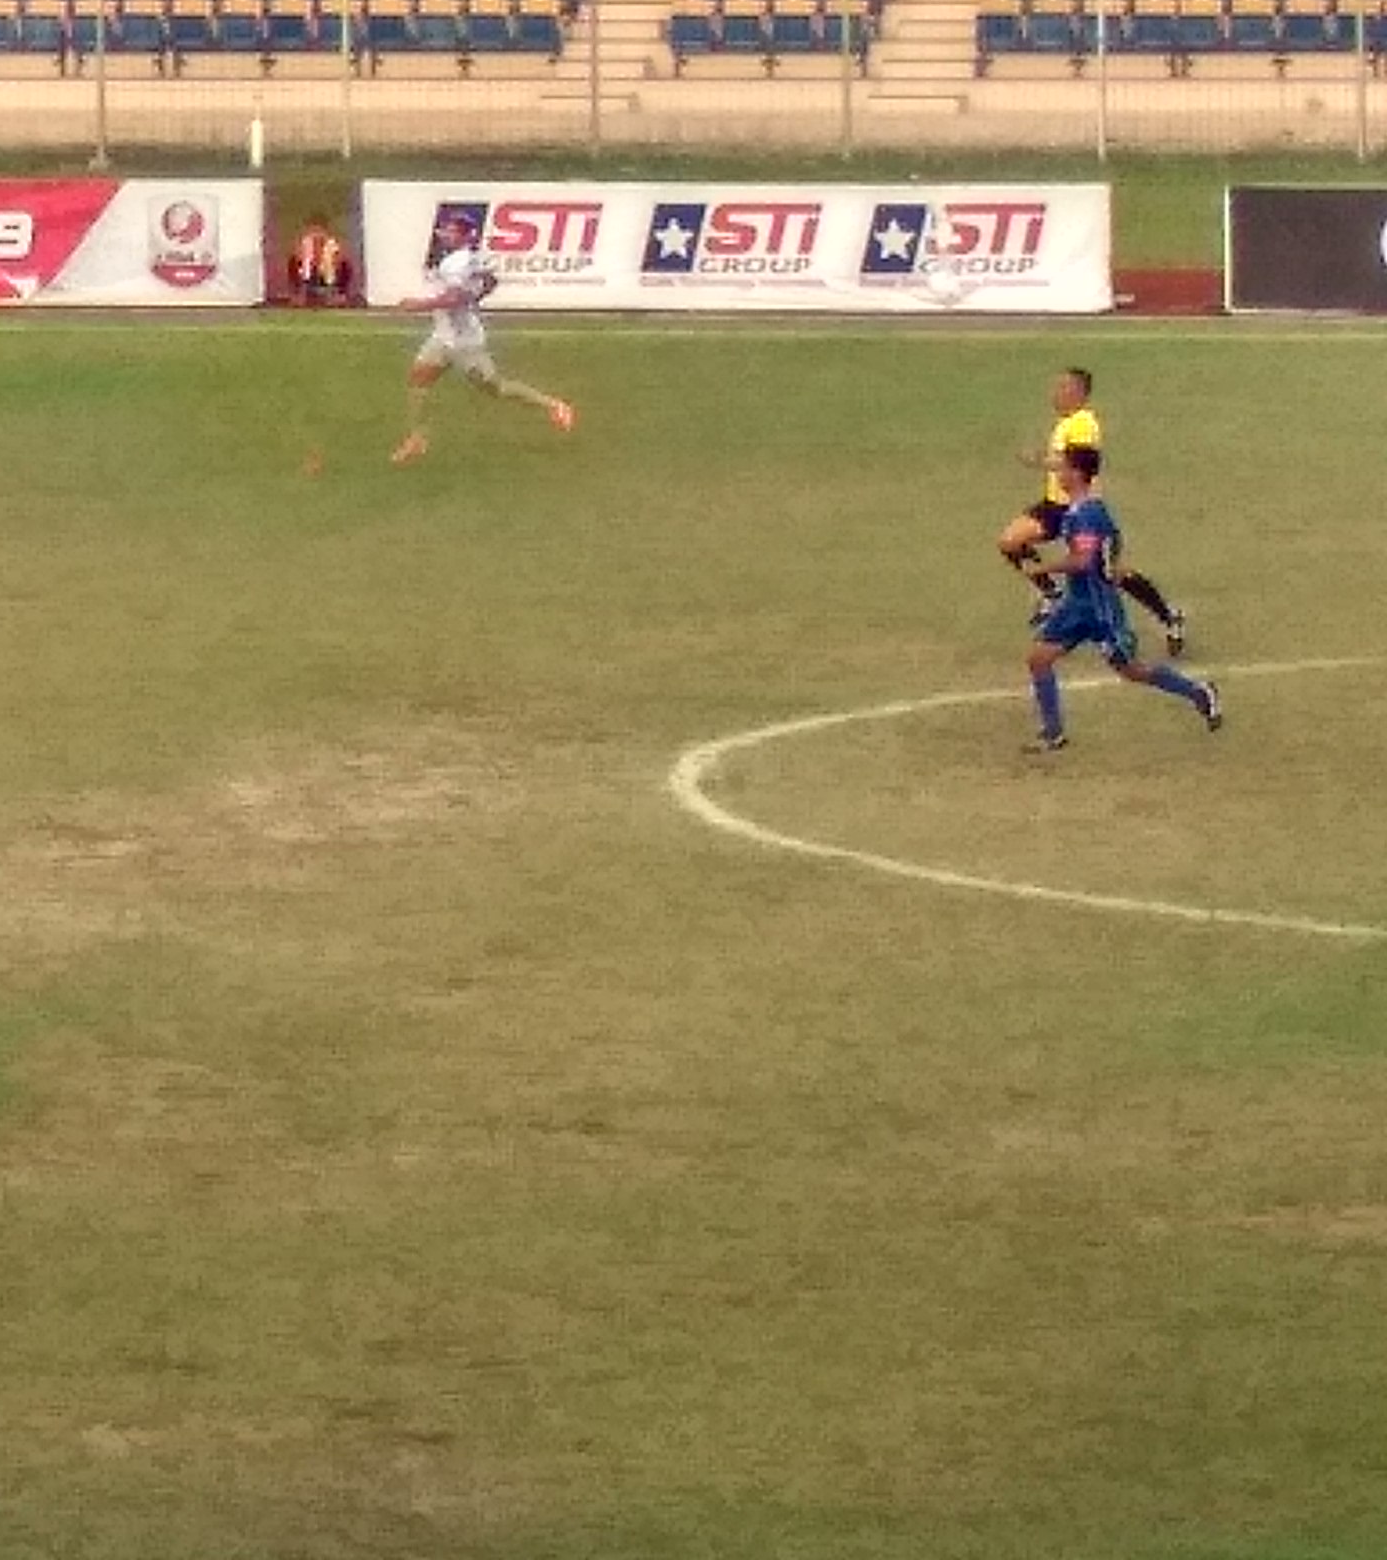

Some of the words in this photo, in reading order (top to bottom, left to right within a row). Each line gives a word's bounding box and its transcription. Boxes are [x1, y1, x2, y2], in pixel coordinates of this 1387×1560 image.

[487, 203, 603, 251] STI
[704, 203, 822, 254] STI
[699, 258, 811, 273] GROUP
